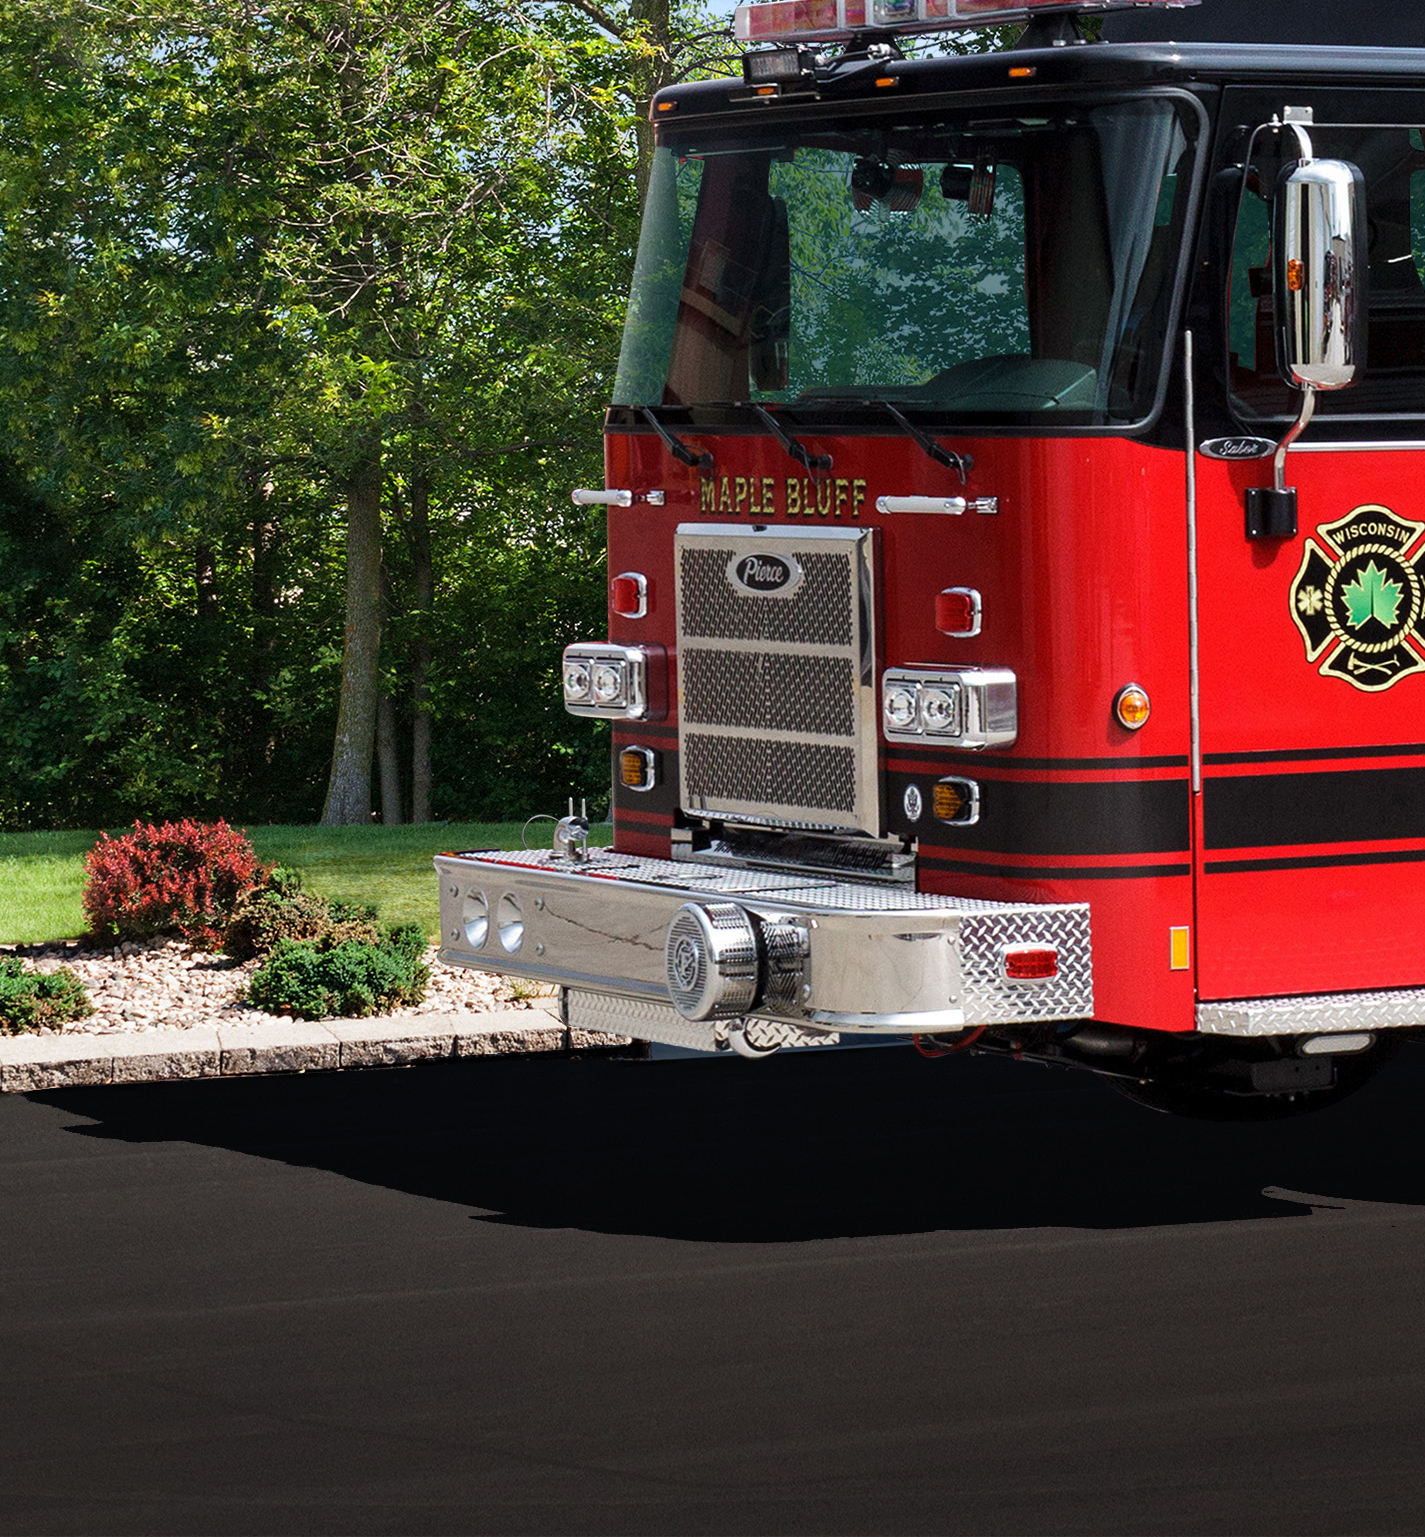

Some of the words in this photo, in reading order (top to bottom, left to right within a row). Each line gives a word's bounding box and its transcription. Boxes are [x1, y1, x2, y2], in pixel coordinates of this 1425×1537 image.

[700, 476, 776, 515] MAPLE
[785, 477, 867, 519] BLUFF
[1332, 522, 1411, 545] WISCONSIN
[743, 556, 785, 585] Pierce
